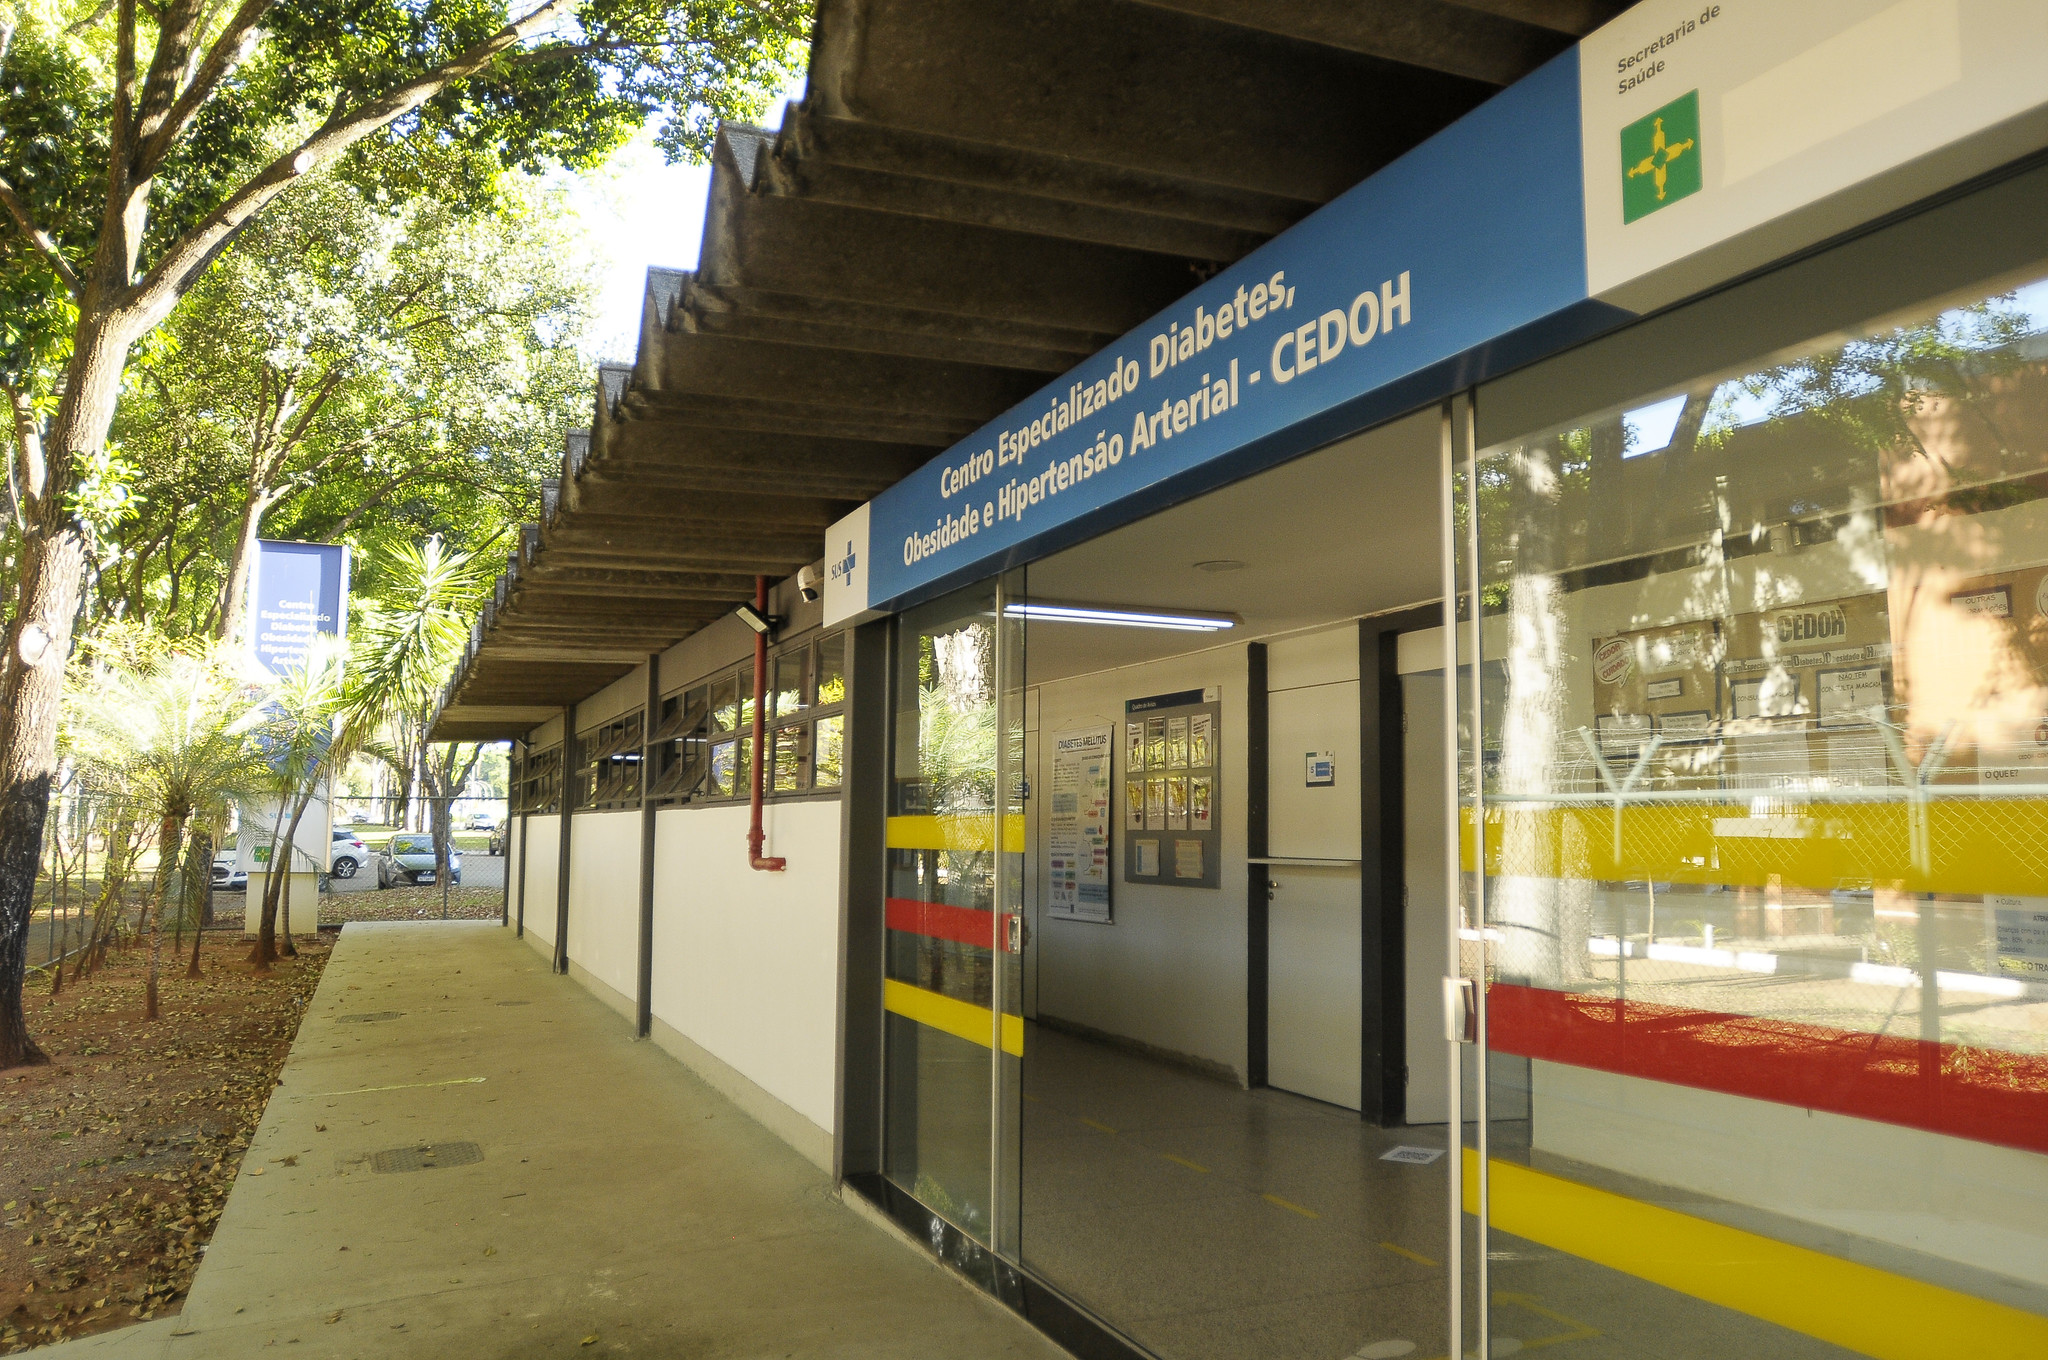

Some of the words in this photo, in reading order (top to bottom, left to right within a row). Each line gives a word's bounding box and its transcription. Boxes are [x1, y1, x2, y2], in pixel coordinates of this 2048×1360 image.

[1618, 20, 1695, 73] Secretaria
[1700, 5, 1720, 25] de
[1619, 60, 1665, 94] Saúde
[941, 448, 994, 498] Centro
[998, 356, 1140, 465] Especializado
[1150, 270, 1295, 378] Diabetes,
[903, 503, 979, 566] Obesidade
[983, 501, 994, 527] e
[998, 429, 1124, 521] Hipertensão
[1130, 357, 1239, 455] Arterial
[1250, 370, 1261, 384] -
[1272, 270, 1411, 383] CEDOH
[831, 561, 841, 580] SUS
[1776, 609, 1845, 643] CEDOH
